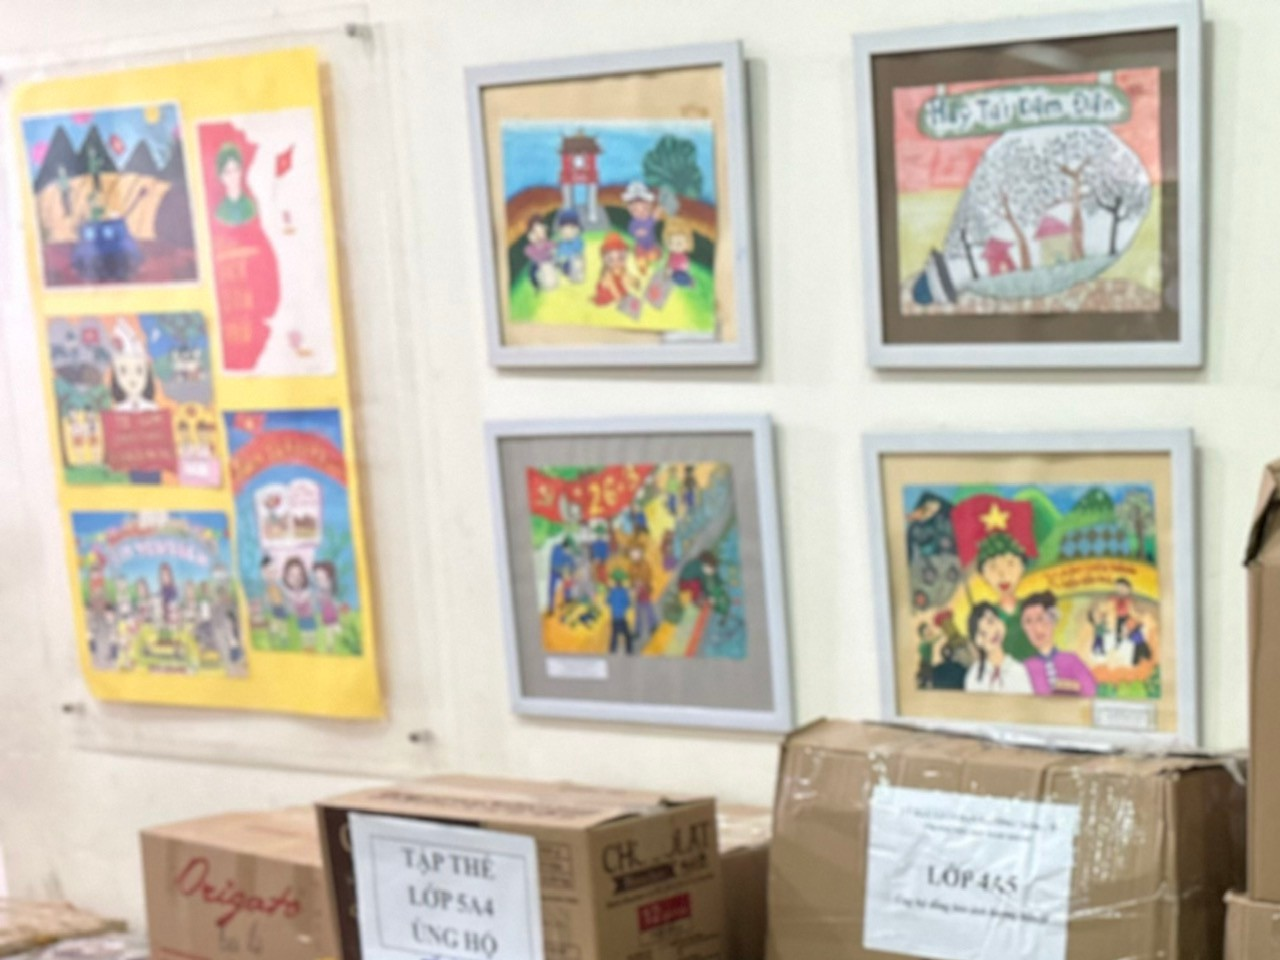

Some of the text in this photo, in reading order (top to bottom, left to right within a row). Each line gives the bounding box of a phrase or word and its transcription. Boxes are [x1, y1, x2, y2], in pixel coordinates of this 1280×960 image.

[402, 846, 446, 877] TẬP
[927, 861, 974, 889] LỚP
[408, 881, 495, 918] LỚP 5A4
[463, 927, 499, 960] HỘ
